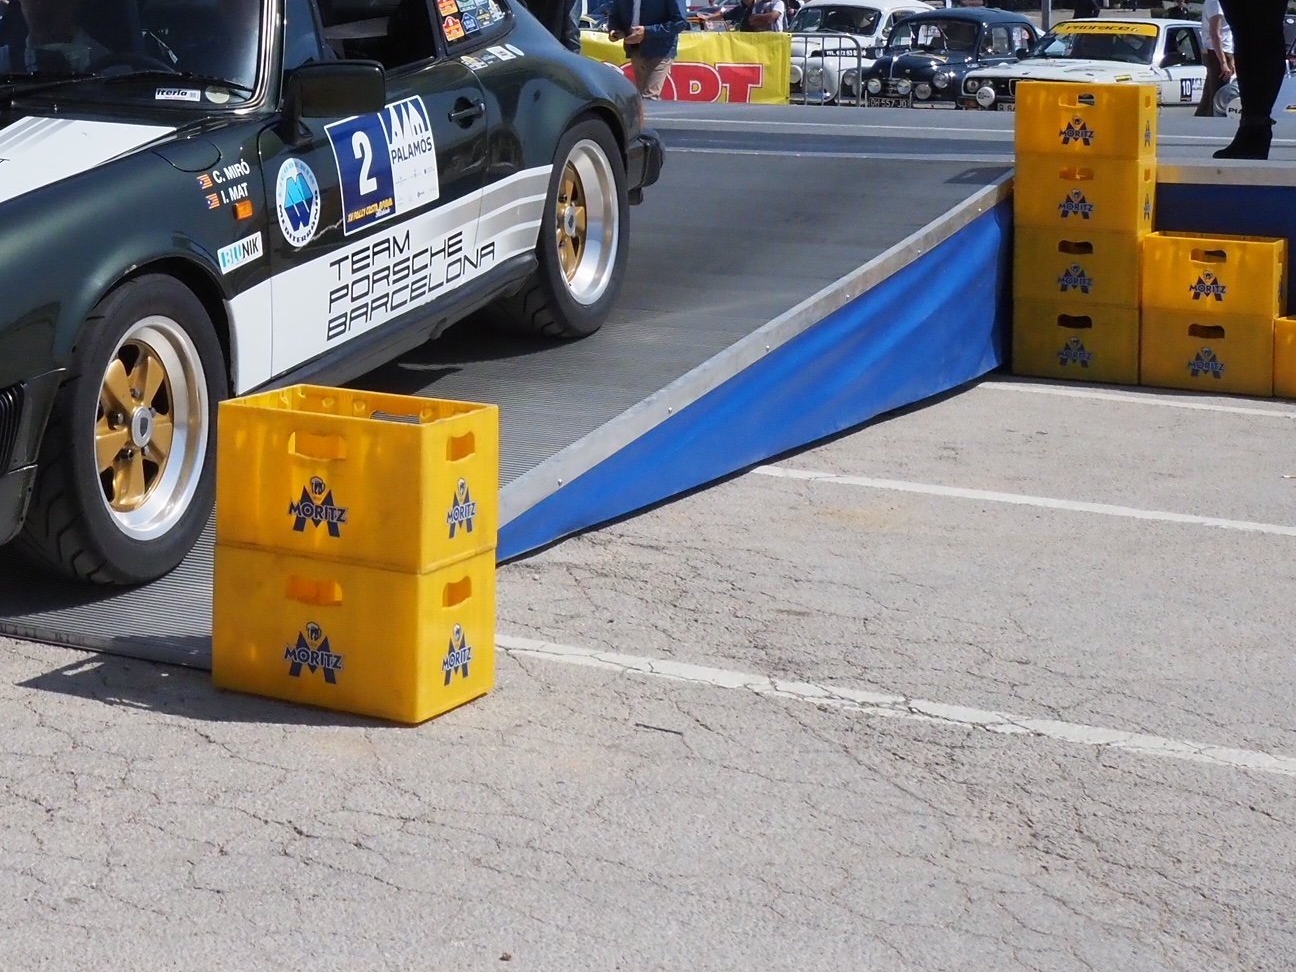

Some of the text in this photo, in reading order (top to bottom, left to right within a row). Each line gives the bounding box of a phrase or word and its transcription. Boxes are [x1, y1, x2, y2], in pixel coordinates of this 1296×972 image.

[1181, 79, 1191, 96] 10
[1059, 128, 1094, 140] MORITZ
[391, 134, 432, 165] PALAMÓS
[212, 158, 250, 184] C. MIRÓ
[351, 131, 378, 196] 2
[229, 183, 249, 201] MAT
[1058, 202, 1094, 212] MORITZ
[220, 236, 260, 268] BLUNIK
[329, 230, 410, 281] TEAM
[329, 231, 463, 314] PORSCHE
[326, 241, 495, 341] BARCELONA
[1189, 284, 1227, 295] MORITZ
[289, 500, 348, 523] MORITZ
[446, 501, 476, 524] MORITZ
[284, 645, 343, 671] MORITZ
[442, 646, 472, 671] MORITZ
